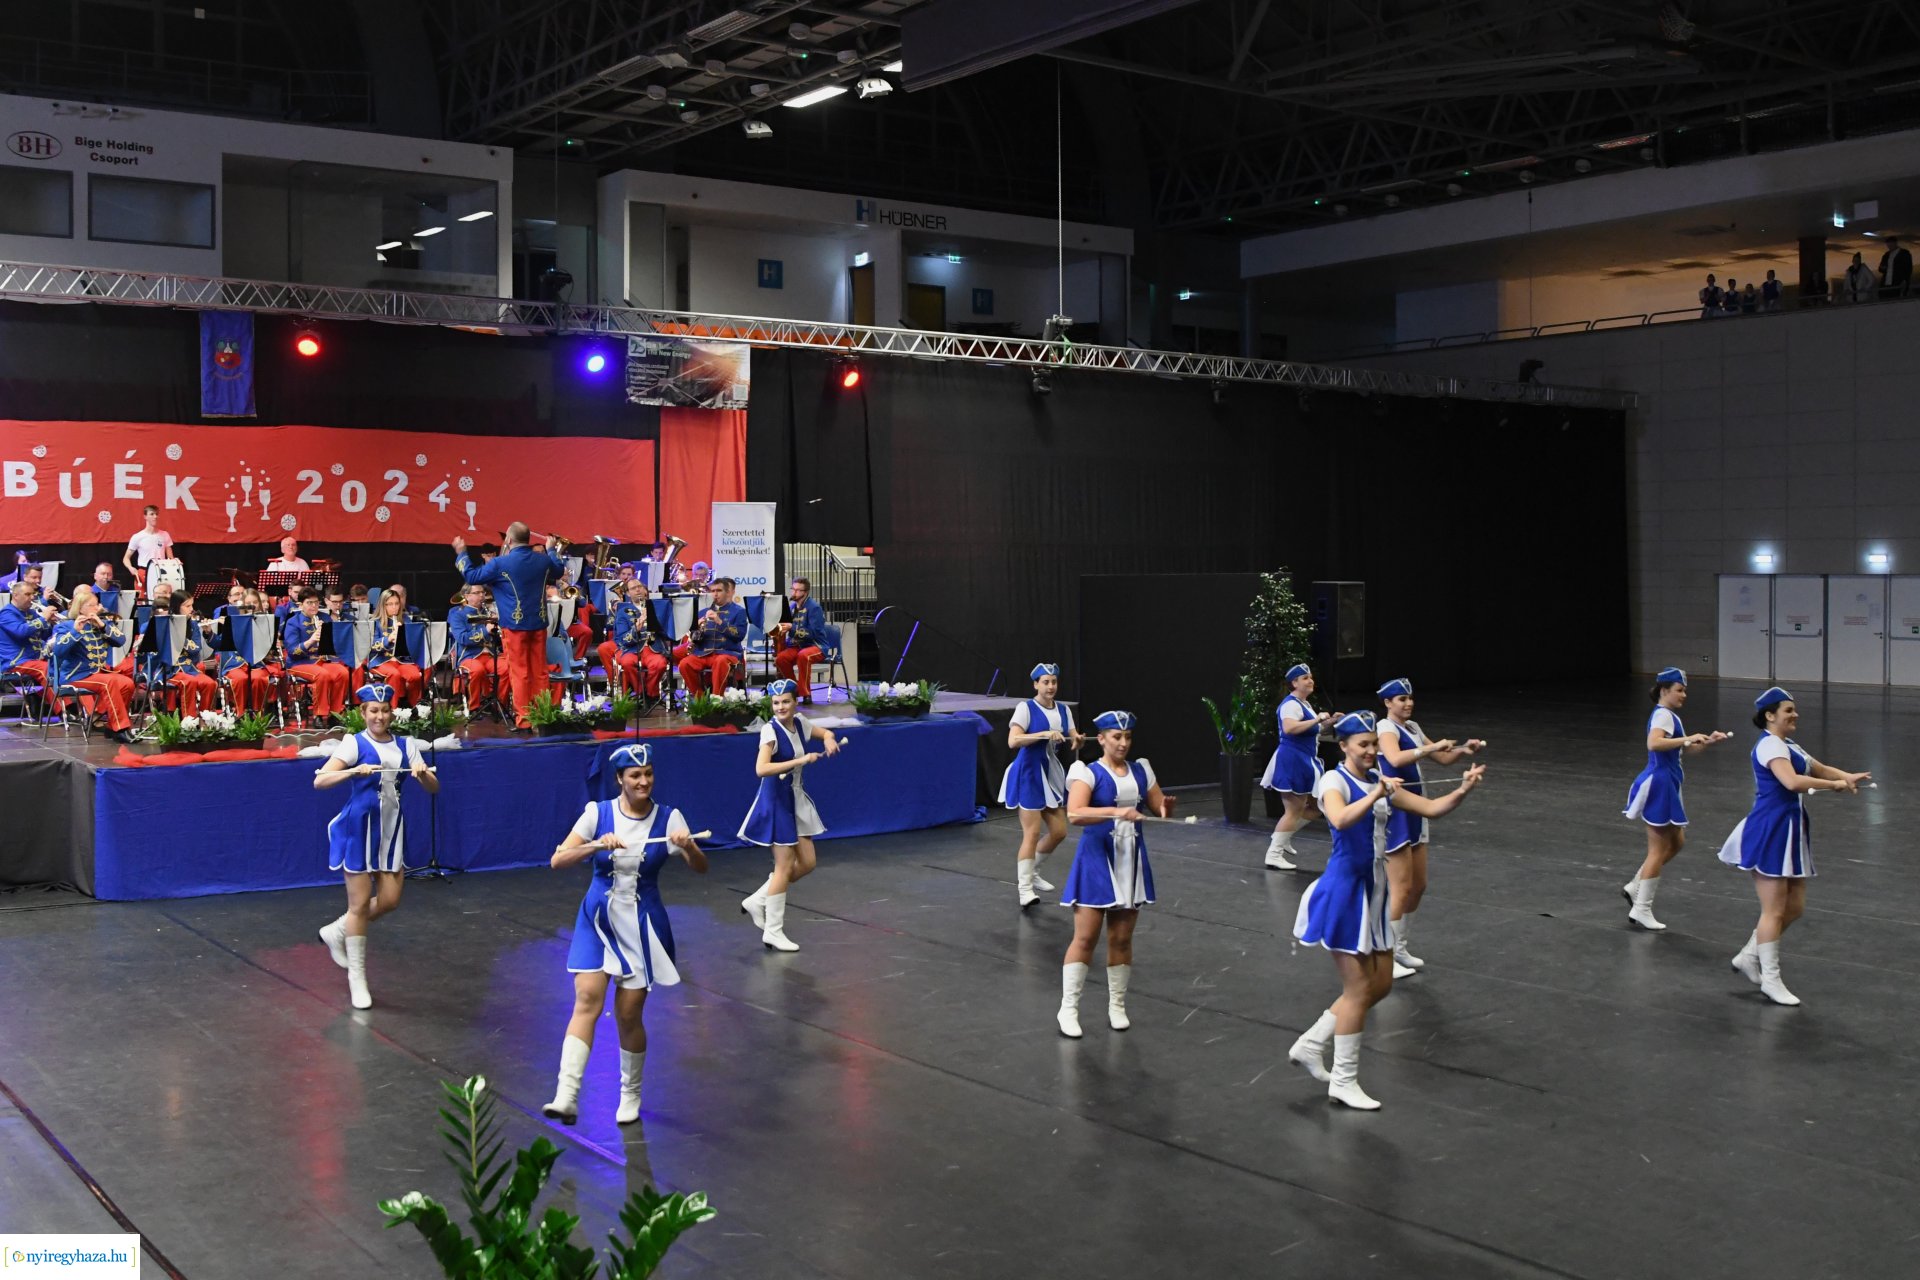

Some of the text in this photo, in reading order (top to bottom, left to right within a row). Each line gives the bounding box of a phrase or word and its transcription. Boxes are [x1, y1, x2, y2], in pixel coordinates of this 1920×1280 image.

[18, 135, 52, 155] BH
[74, 136, 154, 154] Bige Holding
[90, 152, 139, 165] Csoport
[879, 209, 947, 230] HÜBNER
[3, 449, 450, 513] BÚÉK 2024
[722, 528, 765, 537] Szeretettel
[722, 538, 765, 547] köszöntjük
[717, 547, 771, 555] vendégeinket!
[734, 576, 767, 585] SALDO
